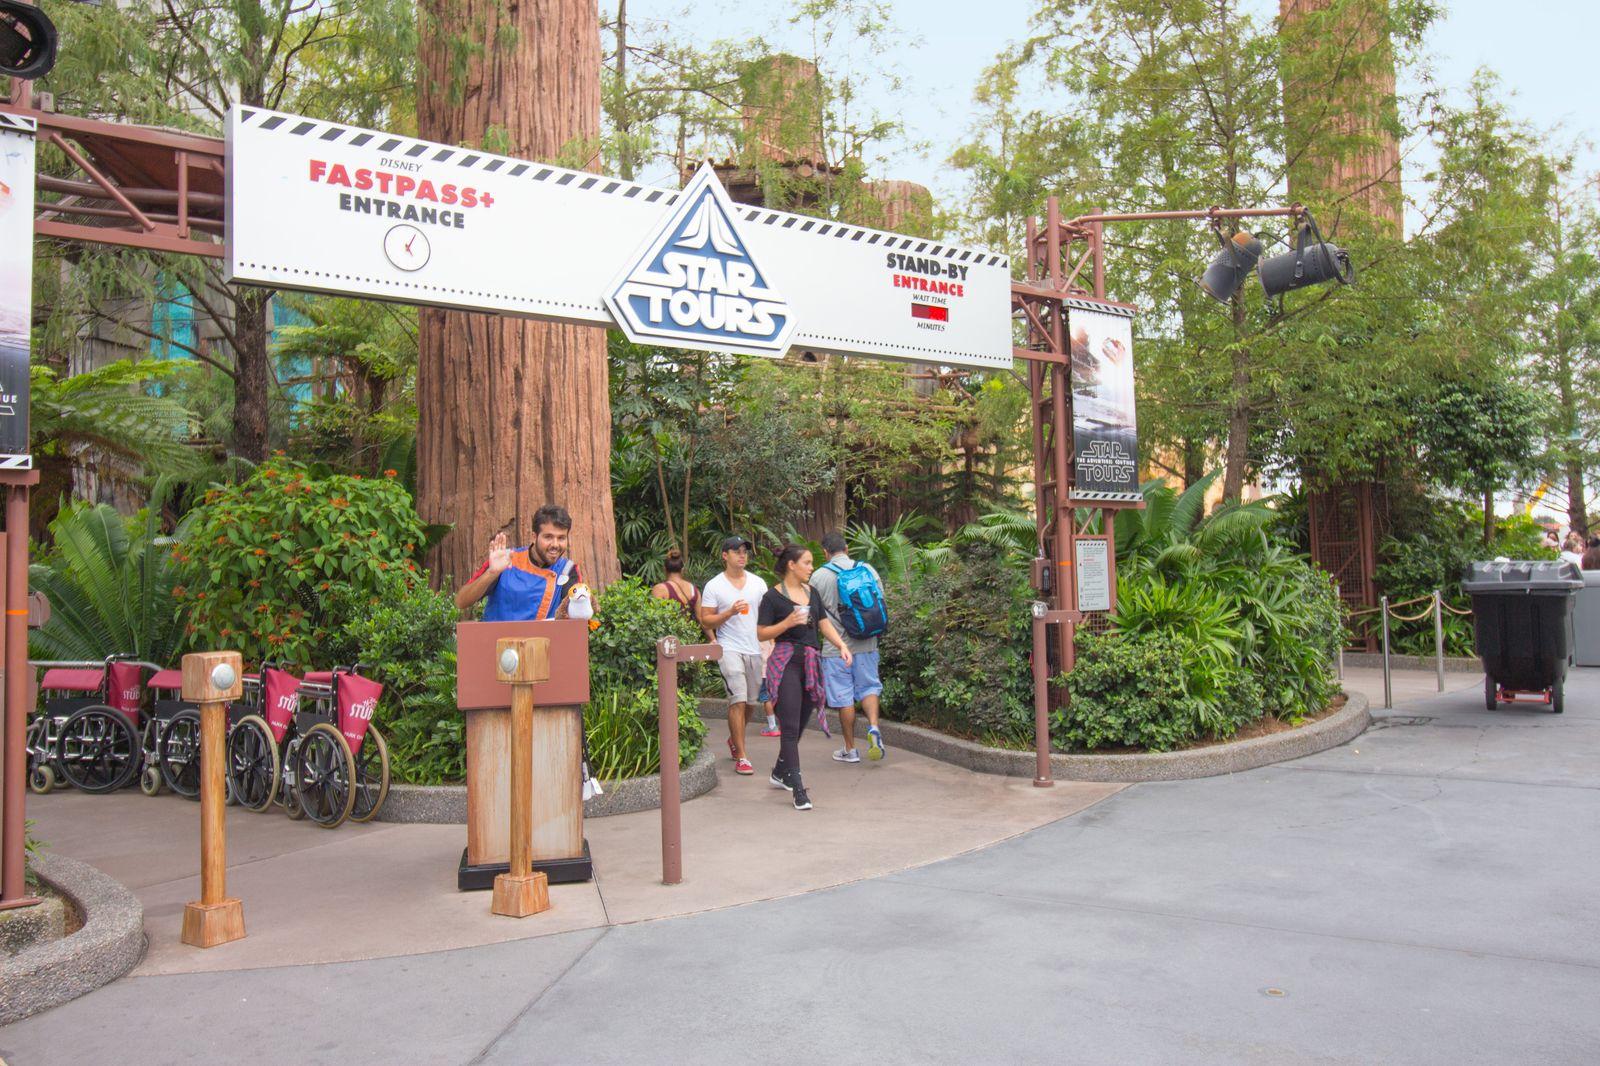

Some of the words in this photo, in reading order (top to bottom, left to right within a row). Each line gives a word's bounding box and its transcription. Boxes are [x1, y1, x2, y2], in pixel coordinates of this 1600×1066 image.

[380, 157, 423, 173] DISNEY
[309, 158, 495, 209] FASTPASS+
[339, 192, 465, 230] ENTRANCE
[628, 250, 786, 304] STAR
[886, 252, 969, 281] STAND-BY
[893, 273, 964, 298] ENTRANCE
[618, 282, 790, 336] TOURS
[912, 293, 930, 303] WAIT
[931, 296, 947, 305] TIME
[916, 321, 946, 332] MINUTES
[1081, 440, 1130, 460] STAR
[1077, 463, 1135, 483] TOURS
